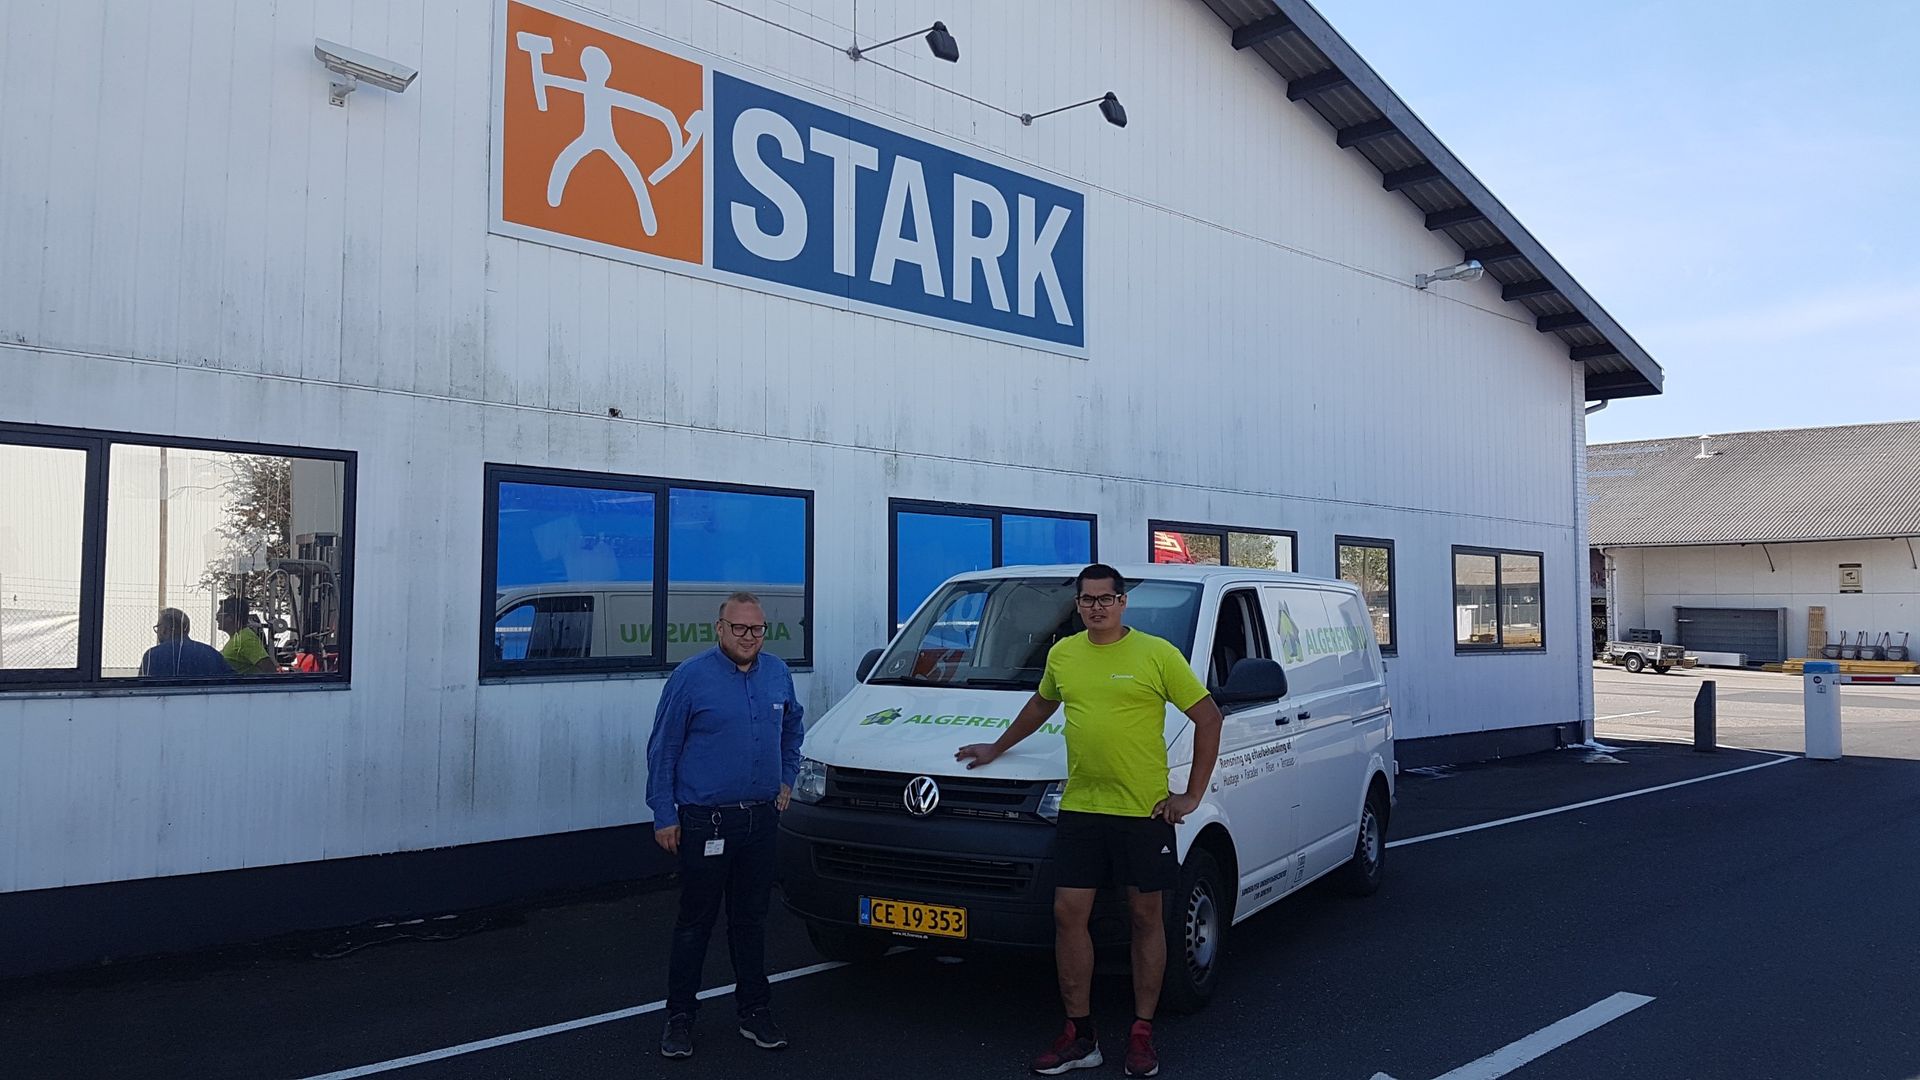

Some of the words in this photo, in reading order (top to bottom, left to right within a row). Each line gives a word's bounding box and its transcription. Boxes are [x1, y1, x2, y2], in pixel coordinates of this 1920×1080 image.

[730, 107, 1073, 326] STARK
[1219, 754, 1245, 768] Rensning
[1244, 752, 1252, 764] og
[872, 902, 895, 924] CE
[902, 906, 923, 928] 19
[928, 909, 963, 932] 353
